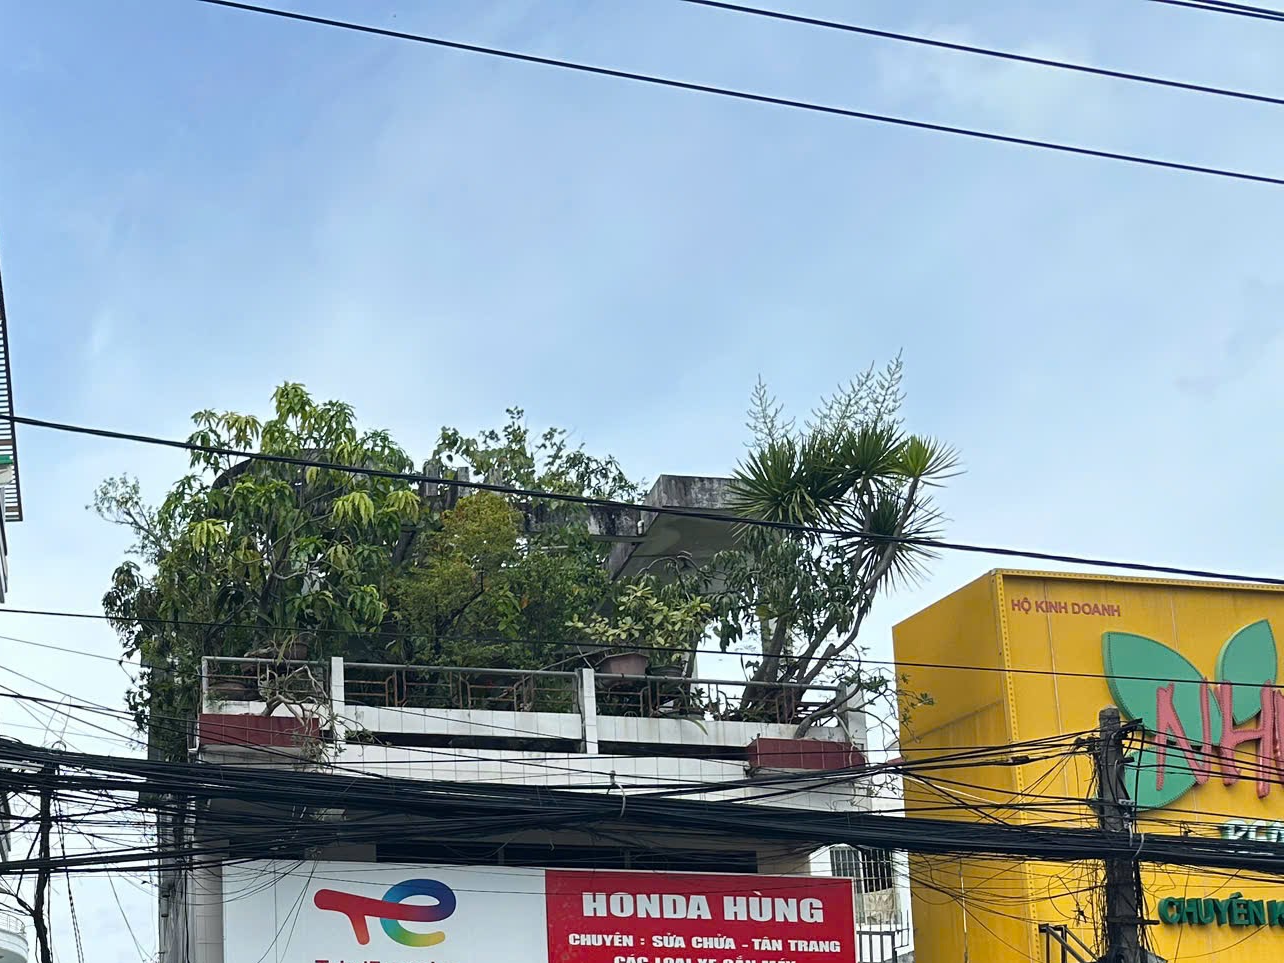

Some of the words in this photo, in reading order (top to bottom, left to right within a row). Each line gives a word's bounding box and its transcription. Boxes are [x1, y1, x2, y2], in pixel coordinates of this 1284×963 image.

[1011, 597, 1031, 614] HỘ
[1035, 600, 1068, 614] KINH
[1071, 603, 1121, 617] DOANH
[582, 892, 712, 920] HONDA
[723, 891, 824, 923] HÙNG
[569, 932, 633, 947] CHUYÊN
[652, 933, 686, 948] SỬA
[752, 937, 782, 951] TÂN
[788, 940, 840, 952] TRANG
